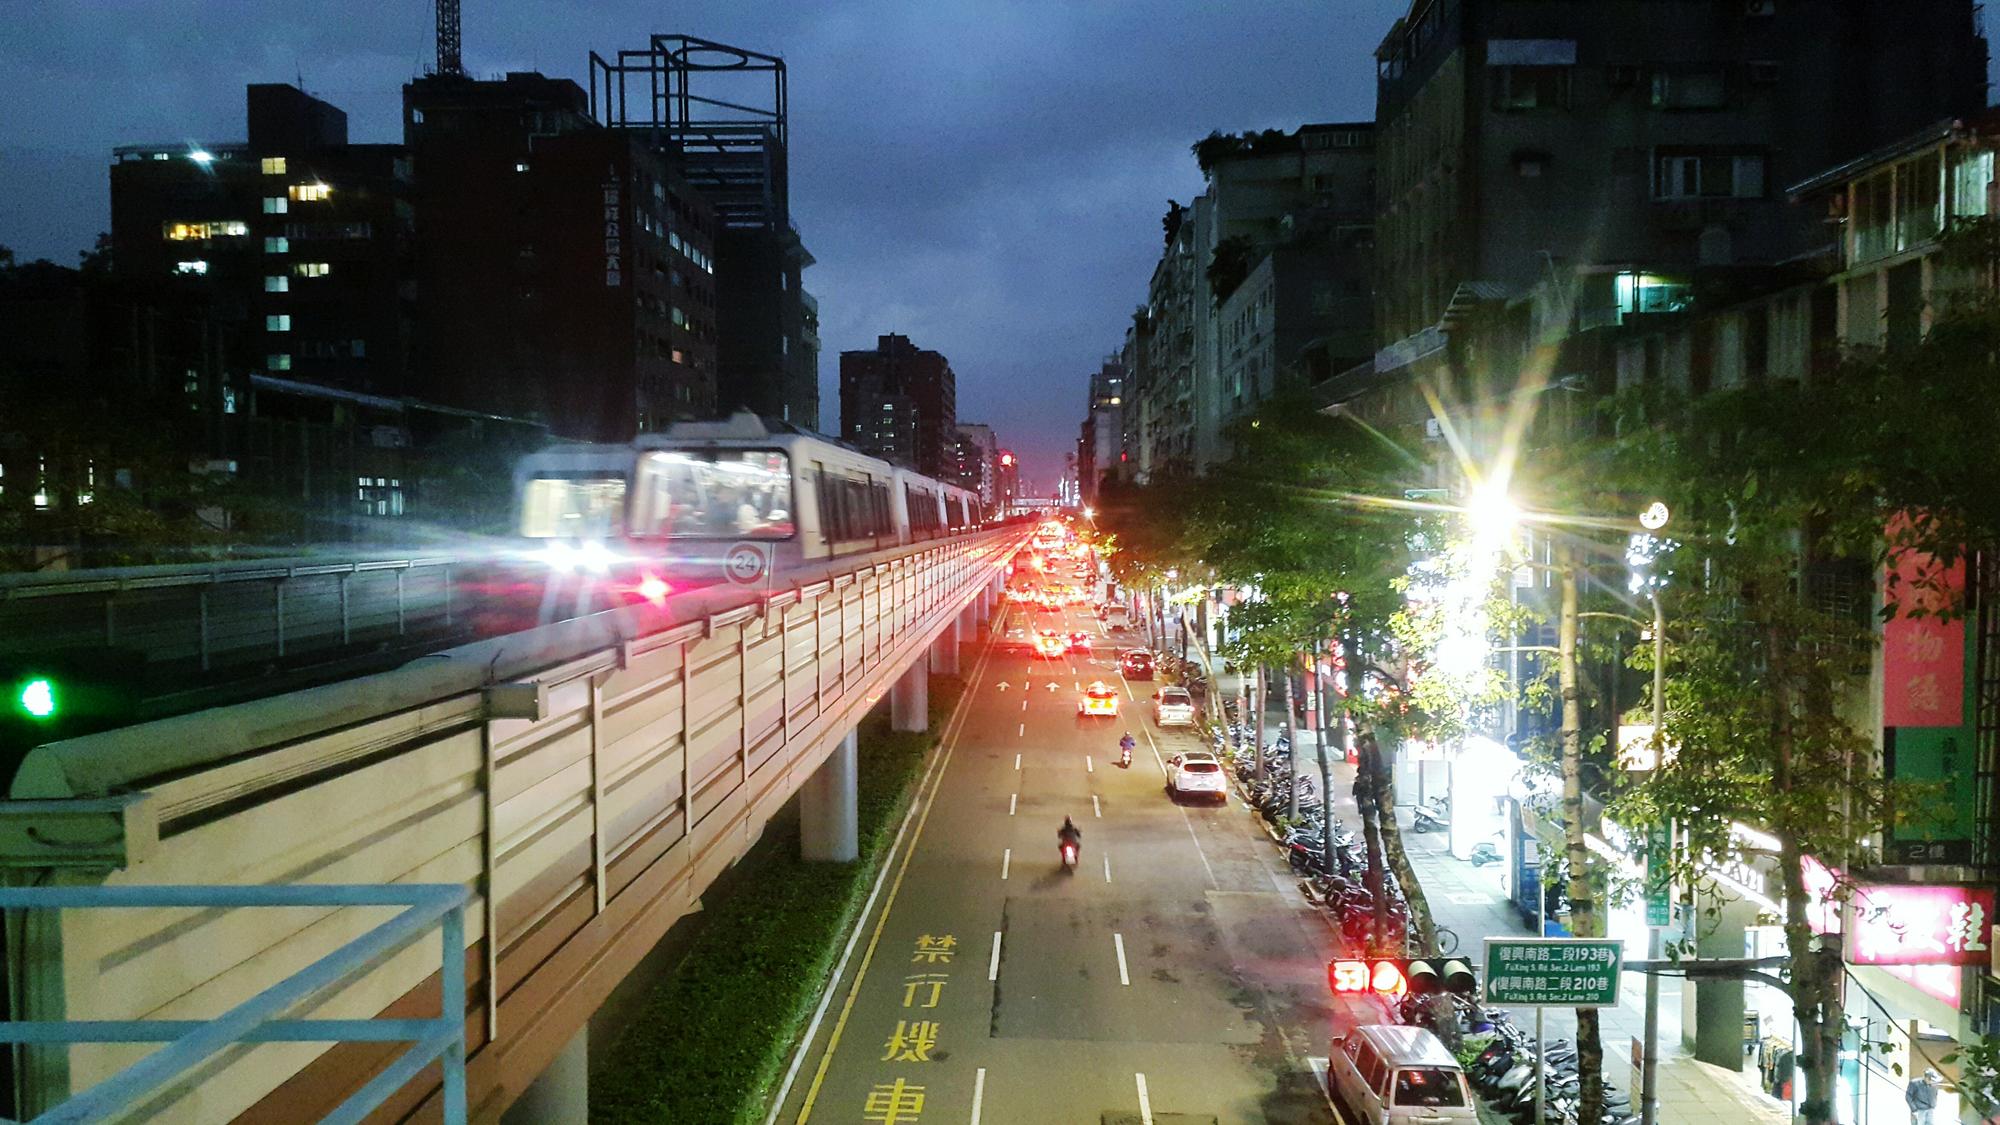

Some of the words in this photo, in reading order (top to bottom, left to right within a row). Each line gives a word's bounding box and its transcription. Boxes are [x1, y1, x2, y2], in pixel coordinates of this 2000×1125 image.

[735, 555, 756, 571] 24
[1499, 946, 1610, 961] 復興南路二段193巷
[1587, 963, 1601, 972] 193
[1497, 976, 1609, 991] 復興南路二段210巷
[1586, 993, 1600, 1001] 210
